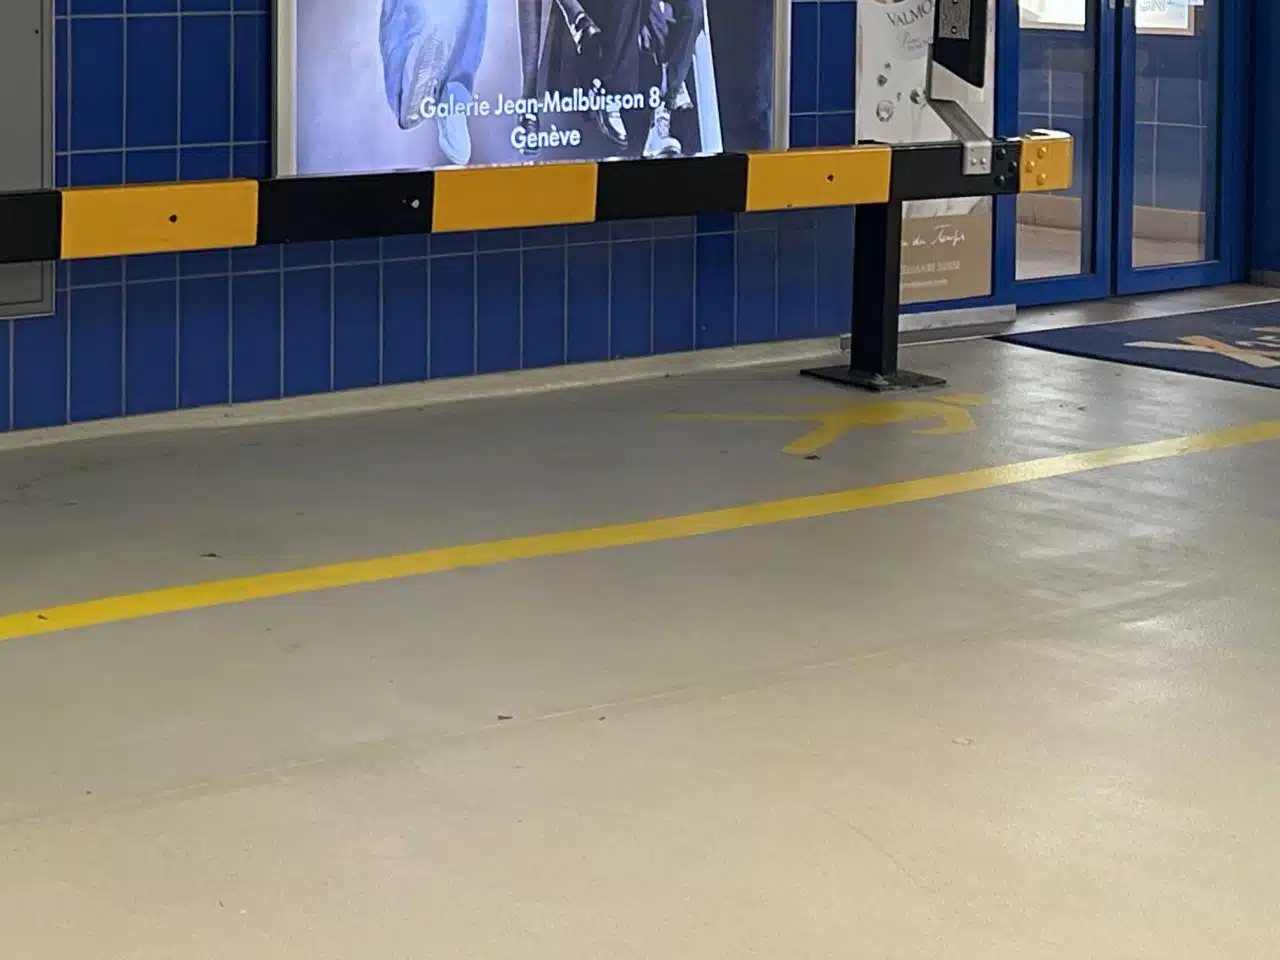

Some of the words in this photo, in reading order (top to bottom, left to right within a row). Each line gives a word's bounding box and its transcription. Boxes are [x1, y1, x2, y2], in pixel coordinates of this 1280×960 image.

[420, 94, 490, 119] Galerie
[495, 89, 644, 116] Jean-Malbuisson
[511, 124, 581, 149] Genève
